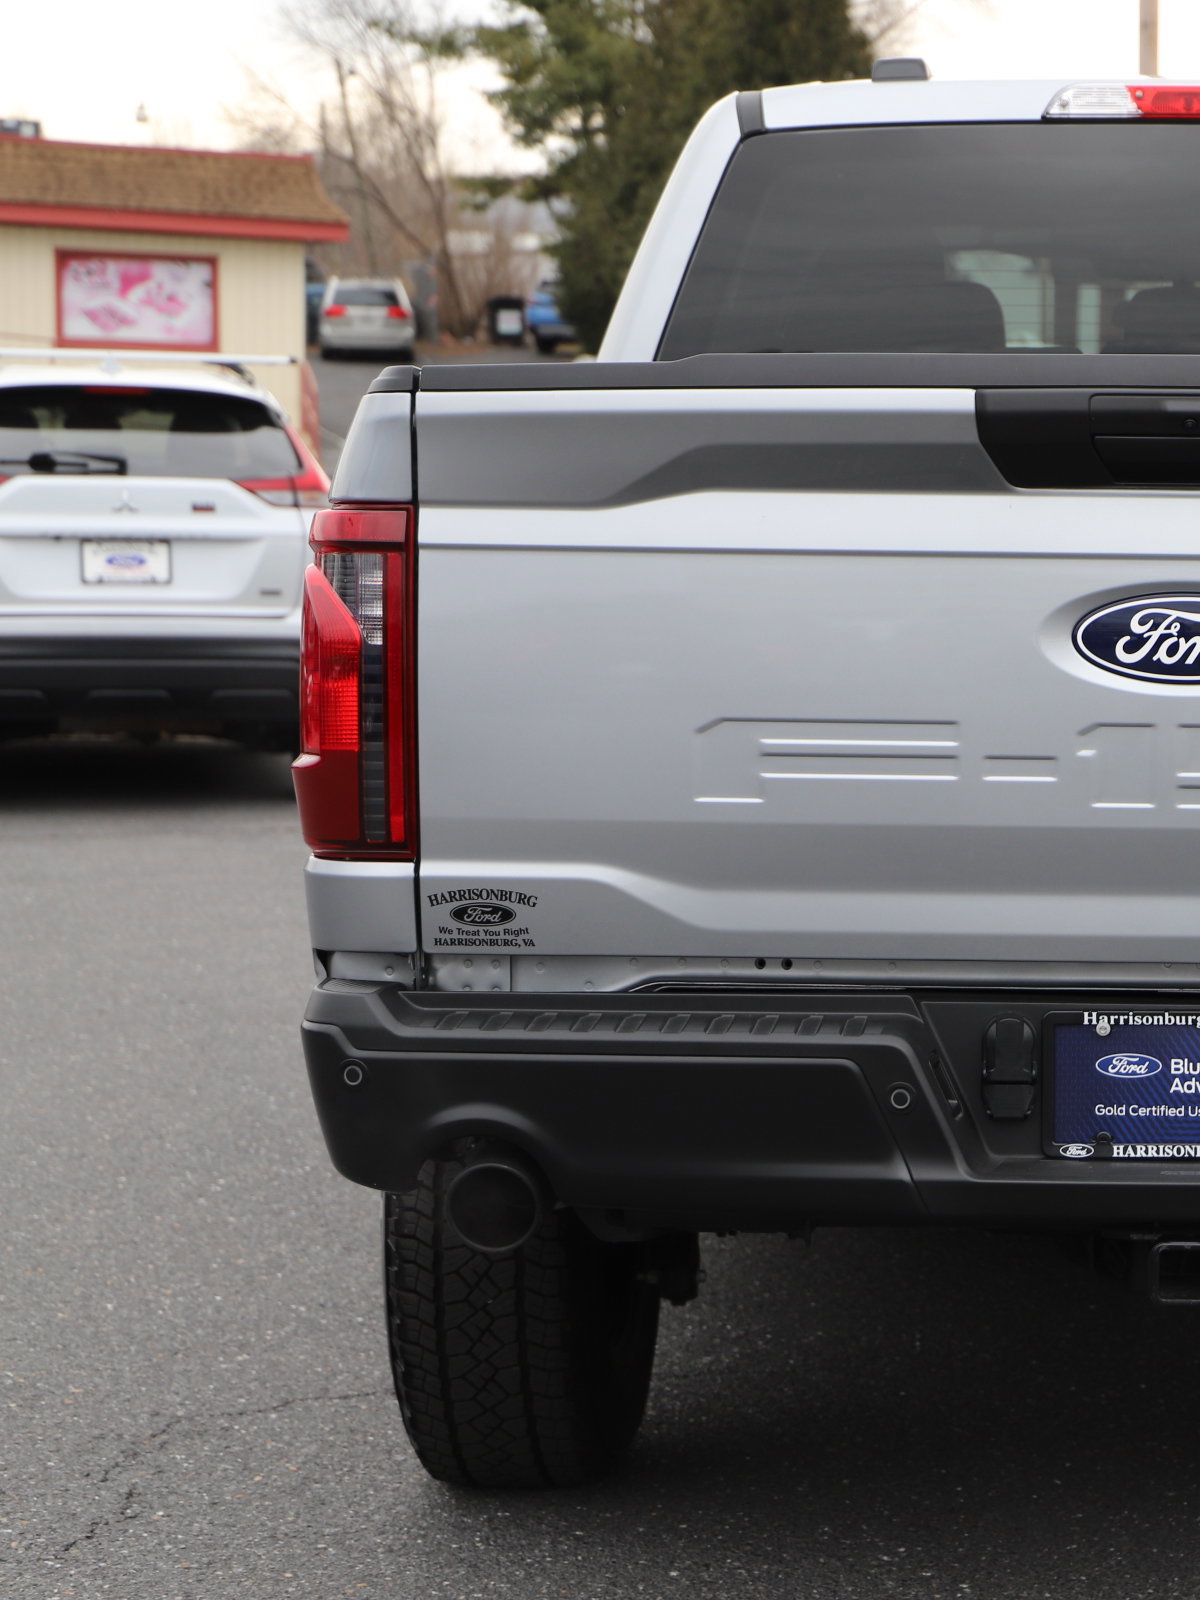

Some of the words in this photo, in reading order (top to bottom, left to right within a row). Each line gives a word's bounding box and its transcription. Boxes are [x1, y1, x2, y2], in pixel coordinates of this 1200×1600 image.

[427, 888, 538, 908] HARRISONBURG
[464, 906, 503, 922] Ford
[439, 926, 454, 935] We
[456, 927, 480, 937] Treat
[482, 929, 501, 937] You
[503, 927, 530, 938] Right
[434, 938, 521, 948] HARRISONBURG,
[522, 939, 536, 947] VA
[1108, 1056, 1150, 1075] Ford
[1094, 1104, 1126, 1117] Gold
[1129, 1104, 1185, 1118] Certified
